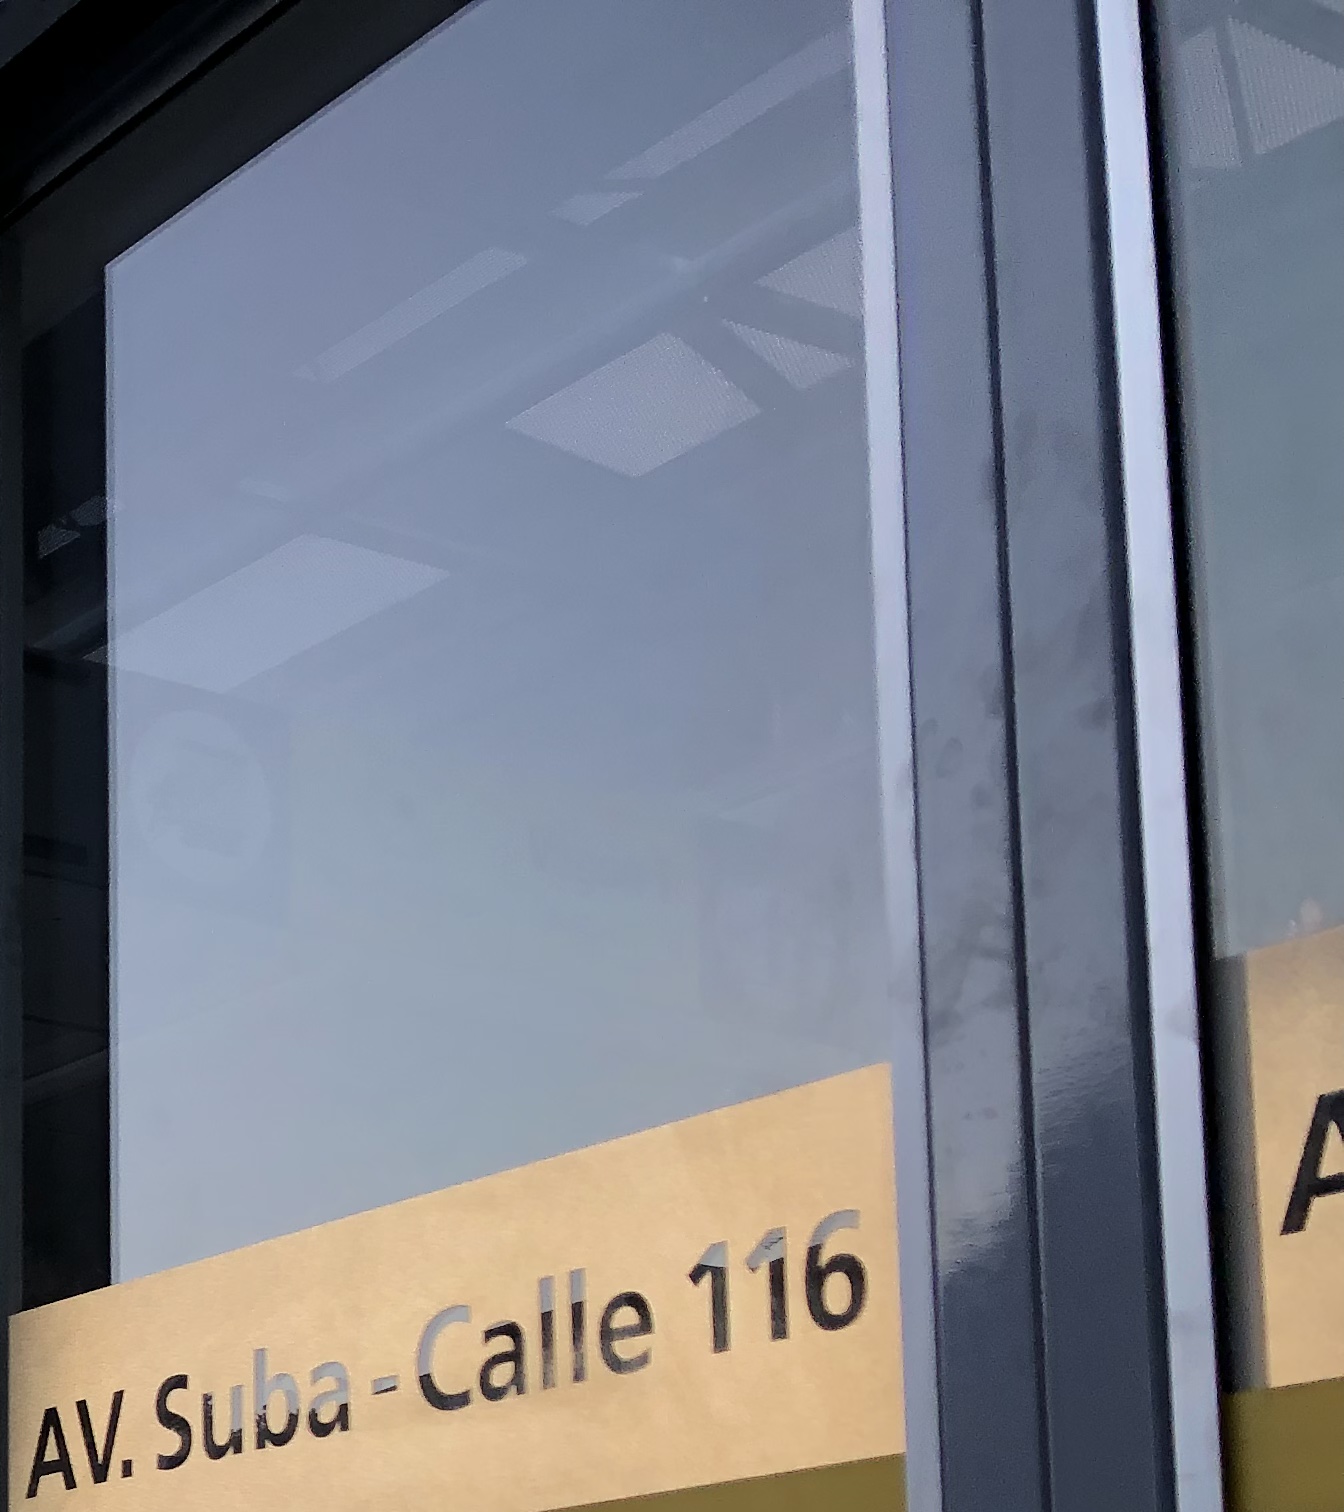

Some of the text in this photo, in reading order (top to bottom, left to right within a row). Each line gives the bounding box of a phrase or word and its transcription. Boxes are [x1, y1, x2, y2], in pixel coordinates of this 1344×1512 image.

[26, 1390, 133, 1499] AV.
[156, 1347, 350, 1470] Suba
[417, 1268, 655, 1411] Calle
[688, 1208, 868, 1354] 116
